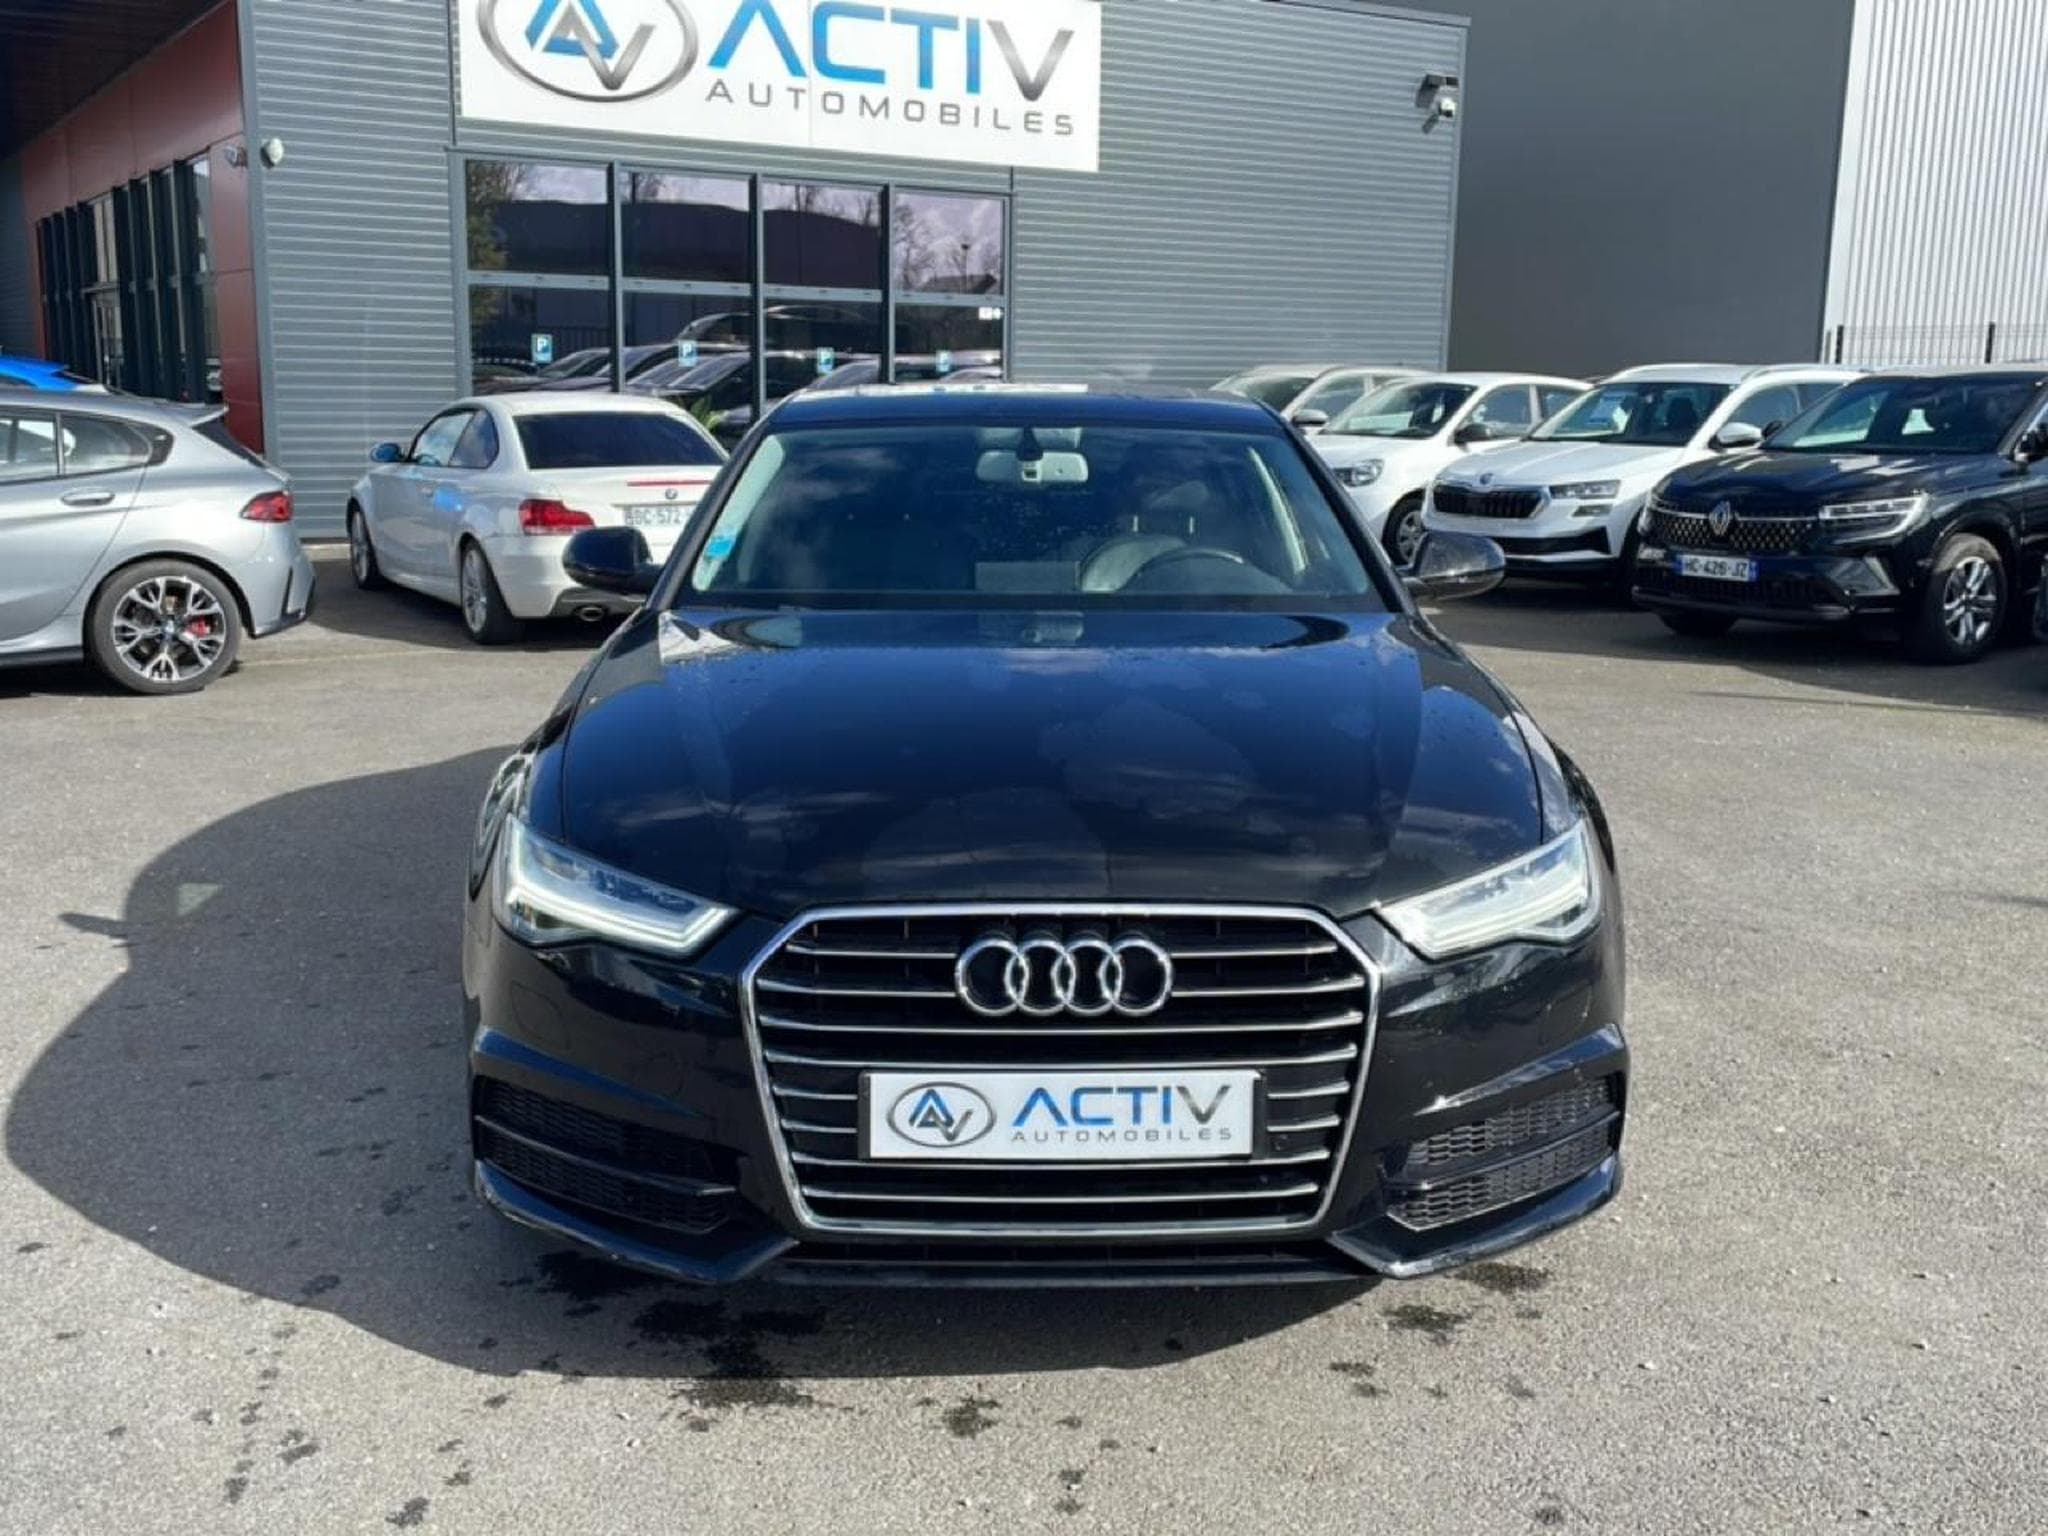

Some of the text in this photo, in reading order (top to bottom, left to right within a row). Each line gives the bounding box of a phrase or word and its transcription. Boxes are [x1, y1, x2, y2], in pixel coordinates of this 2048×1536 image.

[707, 0, 1075, 101] ACTIV
[704, 78, 1074, 136] AUTOMOBILES
[1012, 1085, 1231, 1126] ACTIV
[1012, 1128, 1232, 1142] AUTOMOBILES
